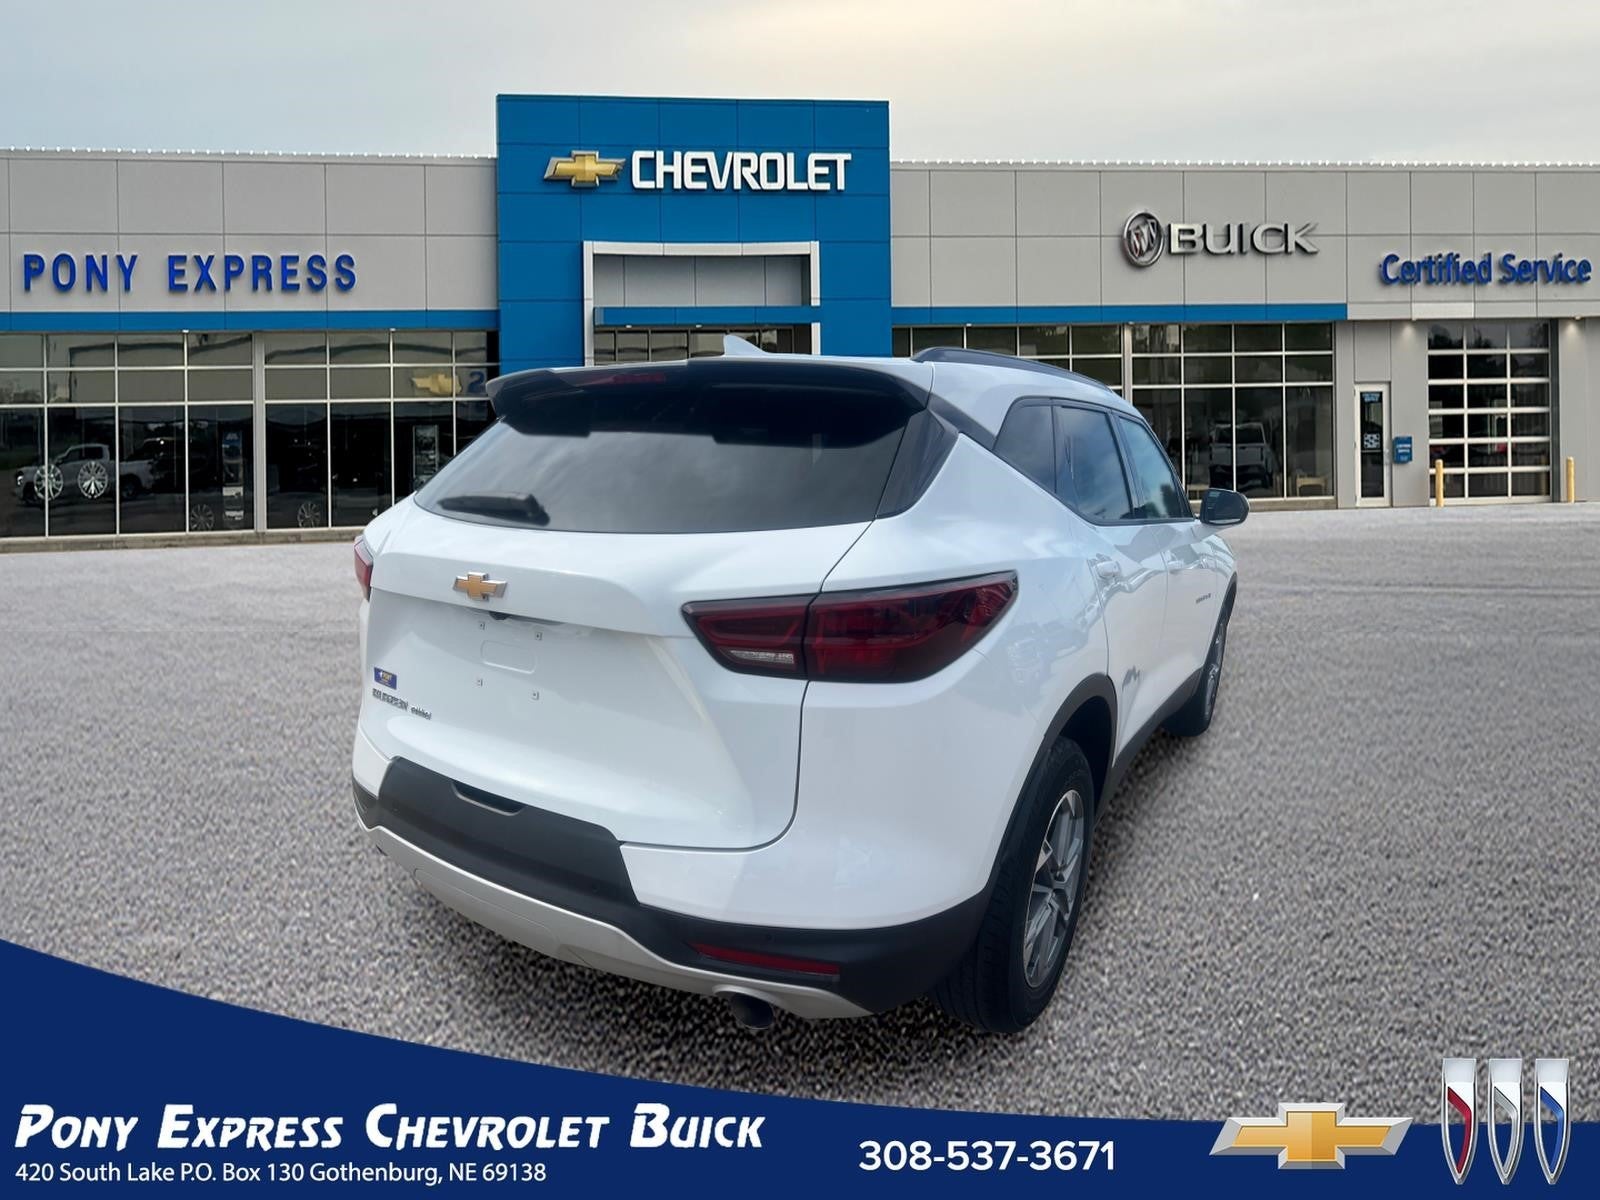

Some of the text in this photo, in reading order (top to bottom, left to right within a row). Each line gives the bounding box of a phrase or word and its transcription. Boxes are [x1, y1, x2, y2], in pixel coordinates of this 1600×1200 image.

[631, 150, 852, 191] CHEVROLET
[1169, 221, 1319, 255] BUICK
[23, 253, 357, 293] PONY EXPRESS
[1379, 252, 1591, 286] Certified Service
